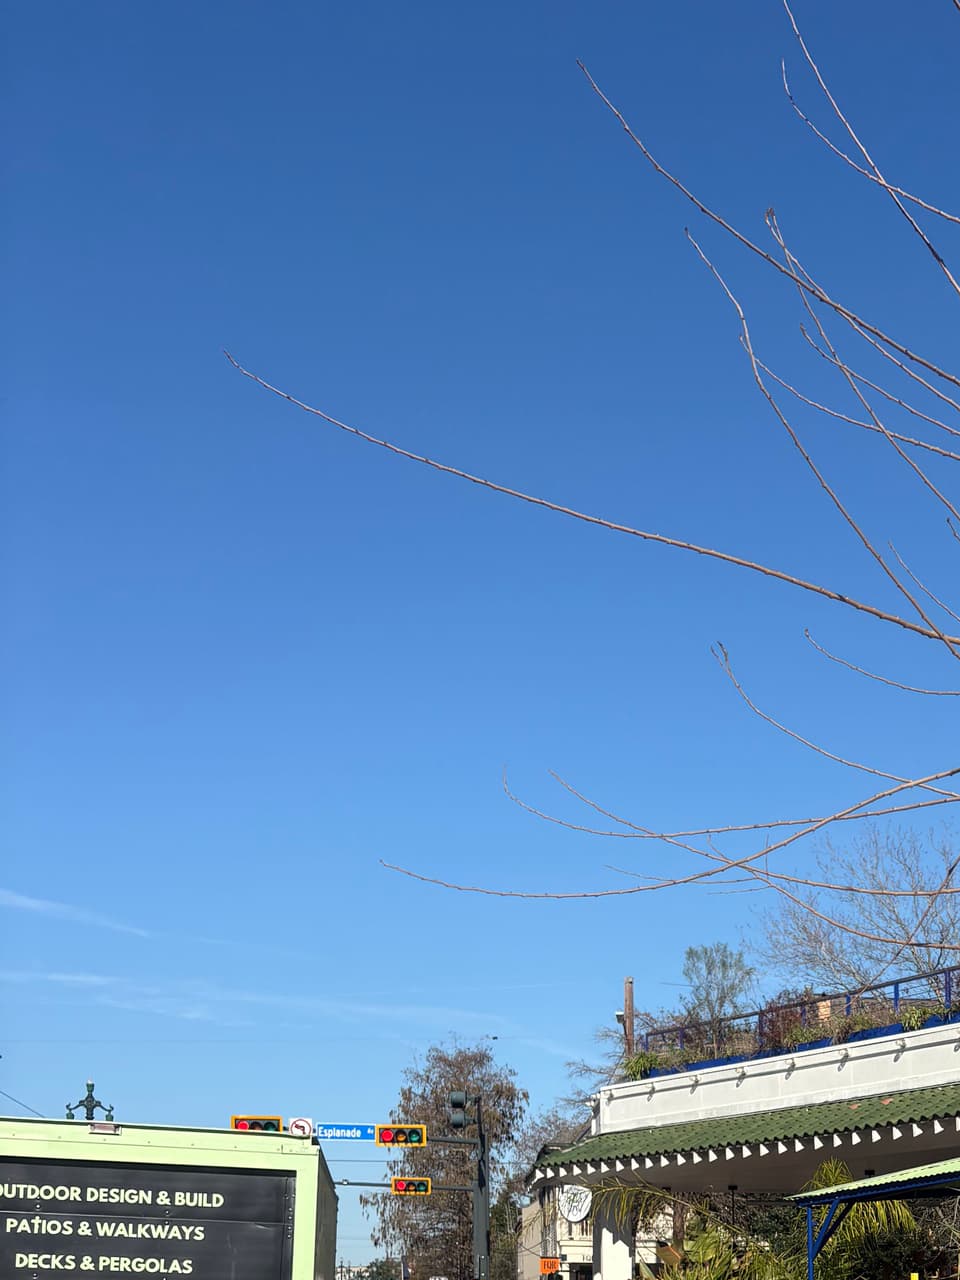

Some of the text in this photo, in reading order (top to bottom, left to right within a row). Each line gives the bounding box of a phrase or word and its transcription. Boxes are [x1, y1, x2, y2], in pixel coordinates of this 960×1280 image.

[318, 1126, 361, 1138] Esplanade
[0, 1183, 225, 1208] UTDOOR DESIGN & BUILD
[5, 1215, 206, 1241] PATIOS & WALKWAYS
[15, 1253, 193, 1274] DECKS & PERGOLAS
